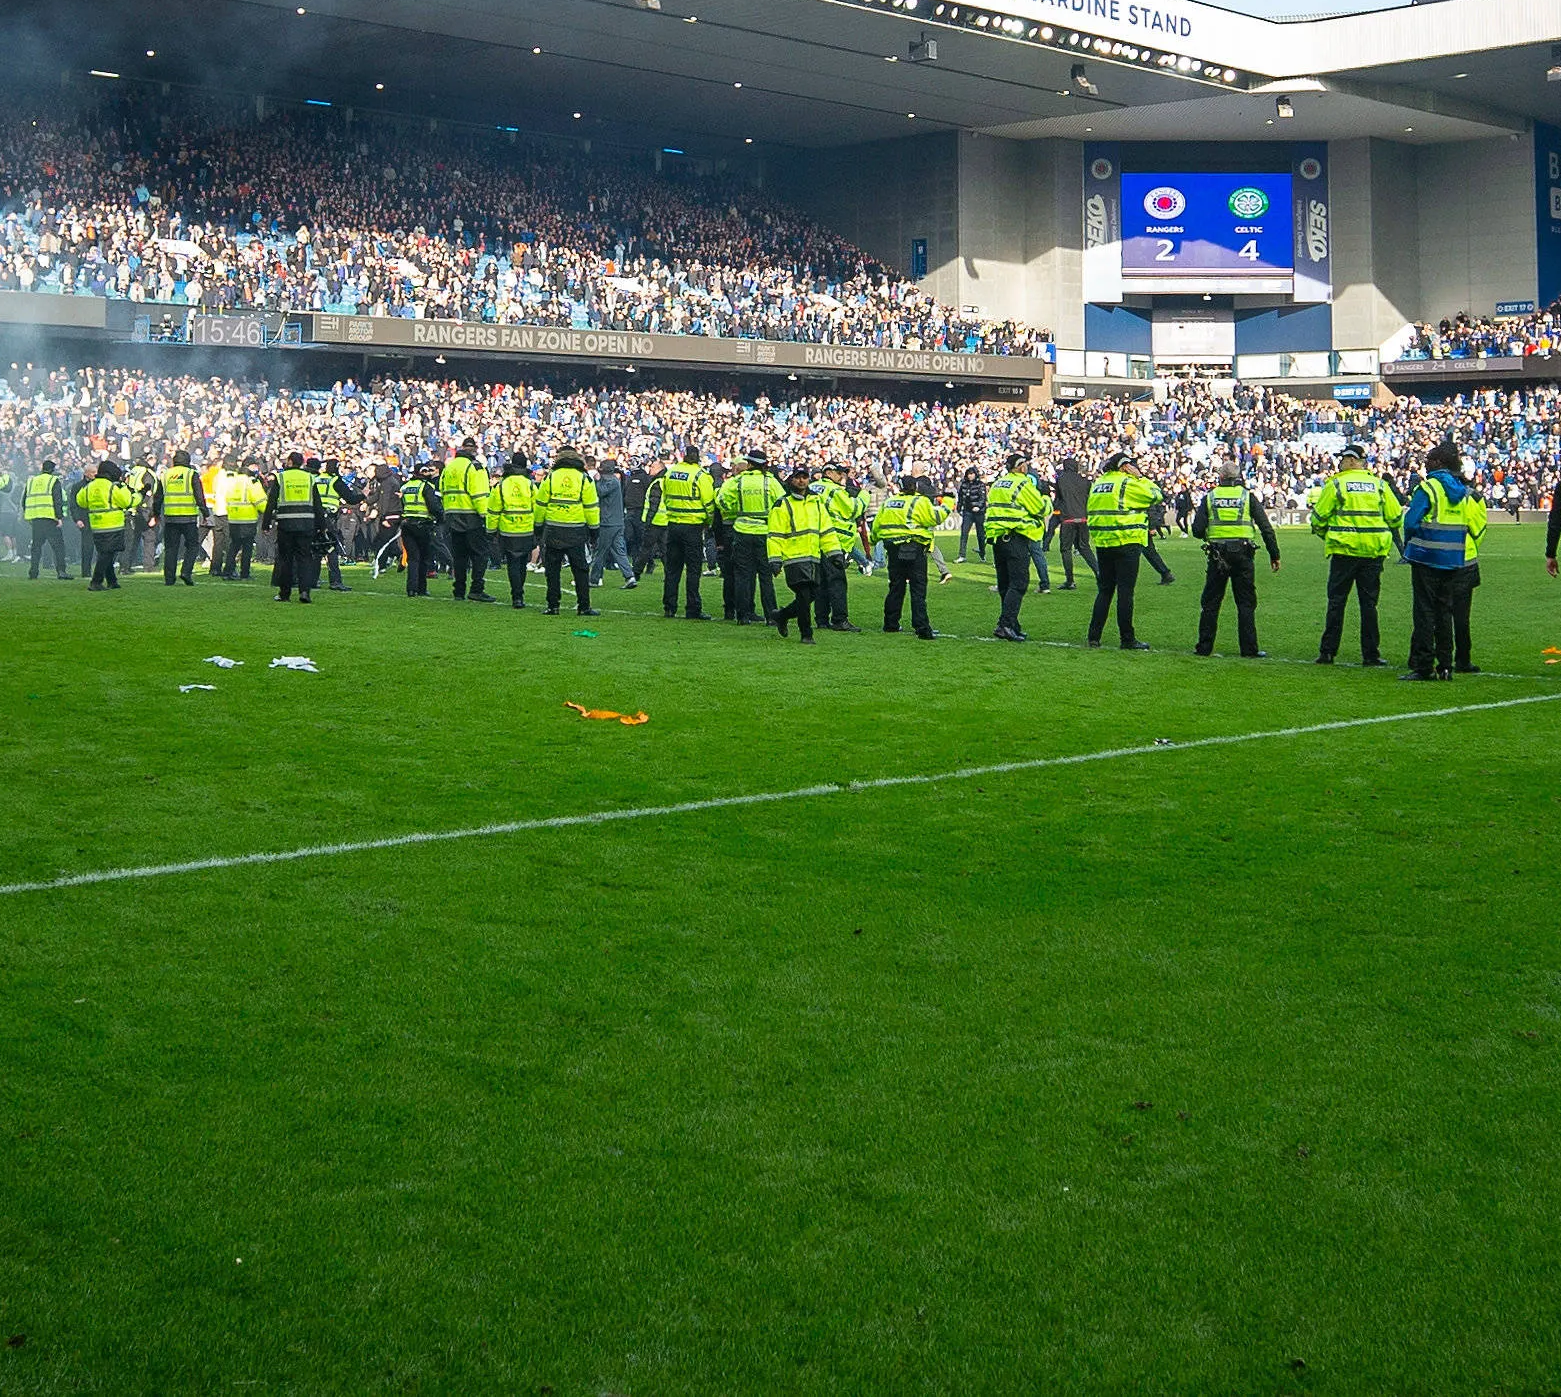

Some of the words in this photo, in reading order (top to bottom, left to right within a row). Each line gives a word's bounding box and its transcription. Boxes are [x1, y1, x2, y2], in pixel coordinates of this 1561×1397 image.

[1127, 6, 1193, 38] STAND
[1146, 226, 1184, 234] RANGERS
[1234, 226, 1263, 234] CELTIC
[1309, 199, 1328, 260] SEKO
[1155, 240, 1176, 261] 2
[1238, 240, 1260, 261] 4
[197, 318, 262, 345] 15:46
[414, 323, 497, 348] RANGERS
[501, 329, 535, 349] FAN
[537, 331, 581, 351] ZONE
[584, 334, 628, 354] OPEN
[632, 336, 654, 354] NO
[805, 347, 868, 367] RANGERS
[870, 351, 895, 367] FAN
[897, 353, 930, 370] ZONE
[933, 354, 965, 371] OPEN
[968, 356, 985, 372] NO
[1394, 363, 1425, 371] RANGERS
[1432, 361, 1446, 370] 2-4
[1454, 361, 1477, 369] CELTIC
[1347, 482, 1376, 492] POLICE
[1214, 498, 1241, 508] POLICE
